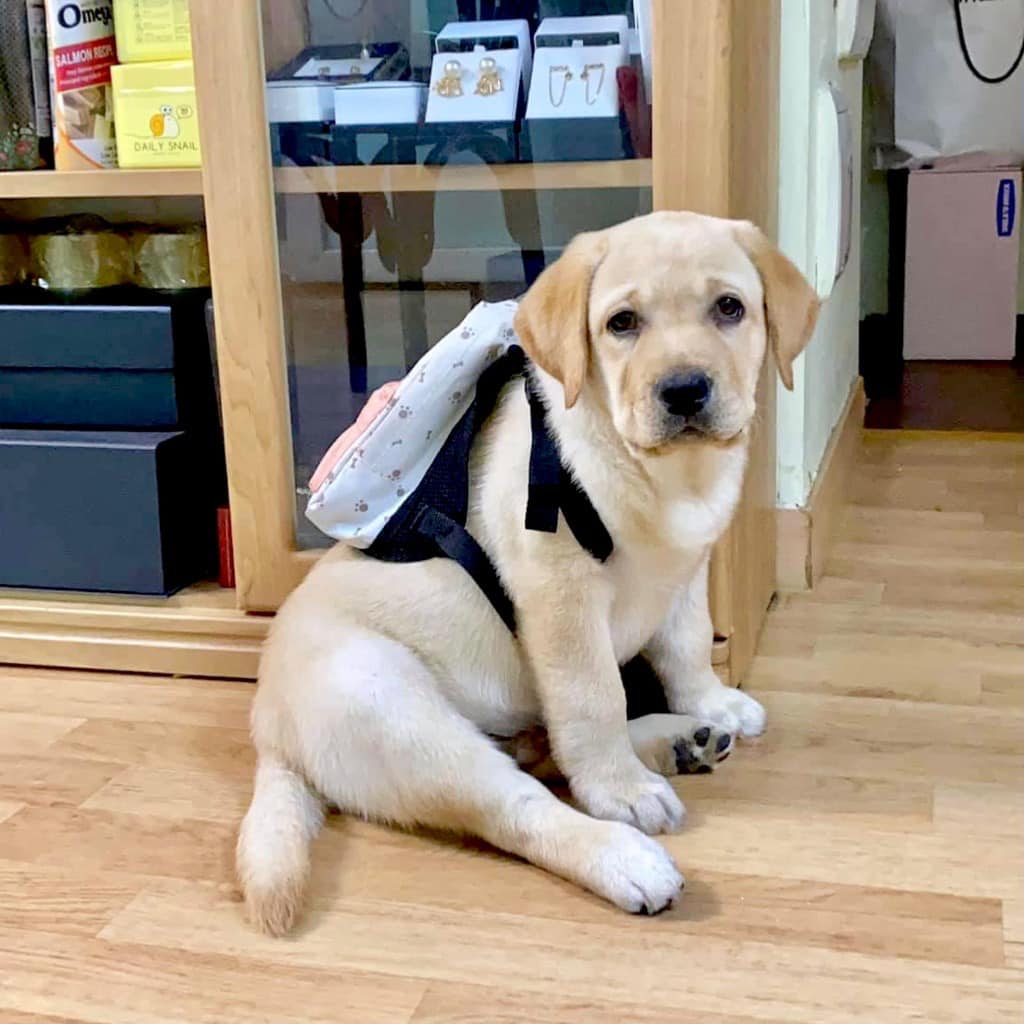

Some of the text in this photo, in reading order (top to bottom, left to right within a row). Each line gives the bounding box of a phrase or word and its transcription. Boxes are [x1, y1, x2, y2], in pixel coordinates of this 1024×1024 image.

[58, 4, 112, 29] Omeg
[55, 49, 93, 67] SALMON
[134, 142, 198, 152] DAILY SNAIL
